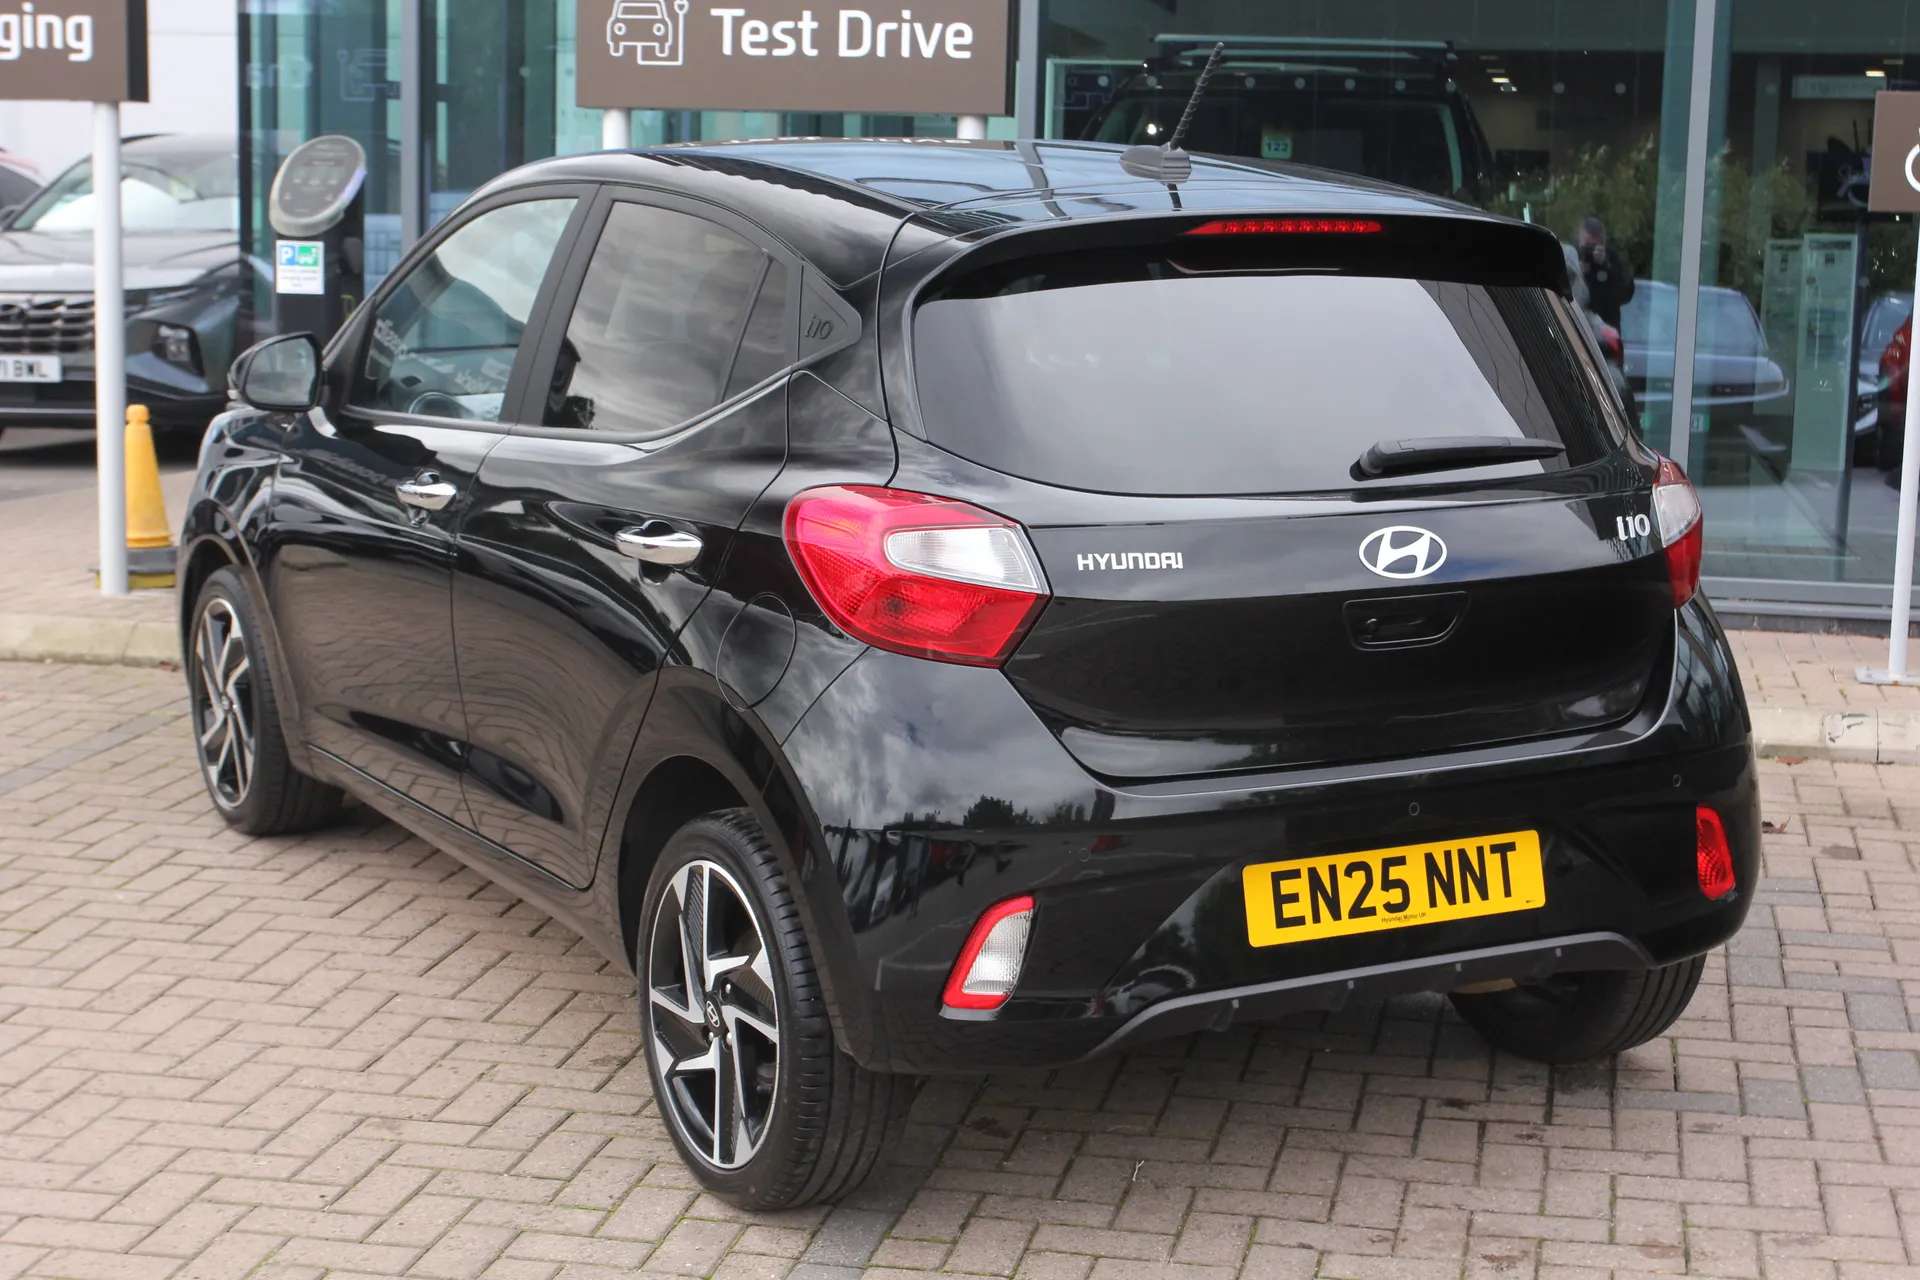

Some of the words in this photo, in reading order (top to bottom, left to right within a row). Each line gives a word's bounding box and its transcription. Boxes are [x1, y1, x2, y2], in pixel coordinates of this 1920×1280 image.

[0, 1, 94, 62] ging
[710, 8, 819, 56] Test
[838, 9, 973, 59] Drive
[1076, 552, 1184, 571] HYUNDAI
[1270, 855, 1411, 929] EN25
[1423, 841, 1517, 909] NNT
